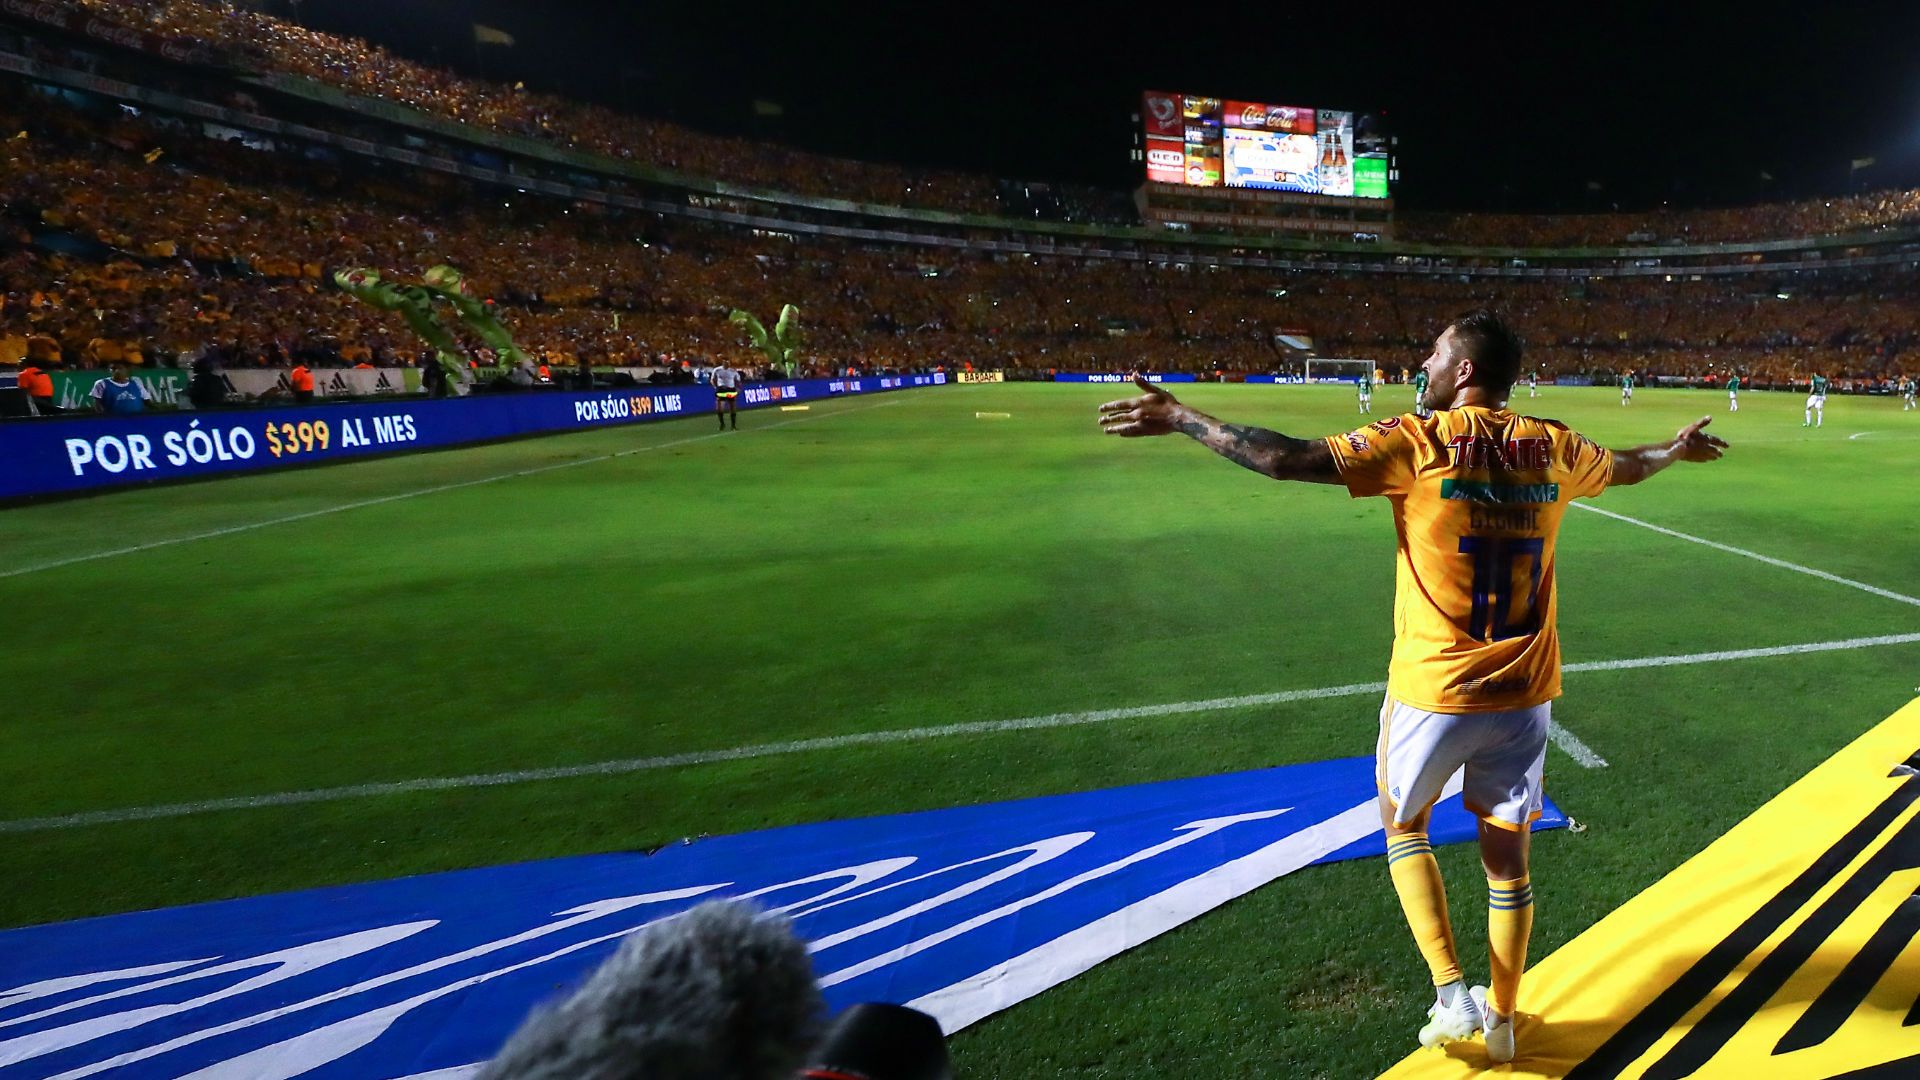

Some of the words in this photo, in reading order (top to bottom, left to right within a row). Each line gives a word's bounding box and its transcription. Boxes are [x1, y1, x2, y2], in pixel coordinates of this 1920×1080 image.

[574, 400, 600, 422] POR
[600, 394, 629, 419] SÓLO
[630, 396, 652, 416] $399
[654, 395, 665, 413] AL
[664, 394, 682, 412] MES
[65, 433, 156, 476] POR
[163, 418, 255, 466] SÓLO
[264, 420, 331, 458] $399
[341, 417, 372, 449] AL
[374, 413, 418, 445] MES
[1457, 535, 1545, 643] 10
